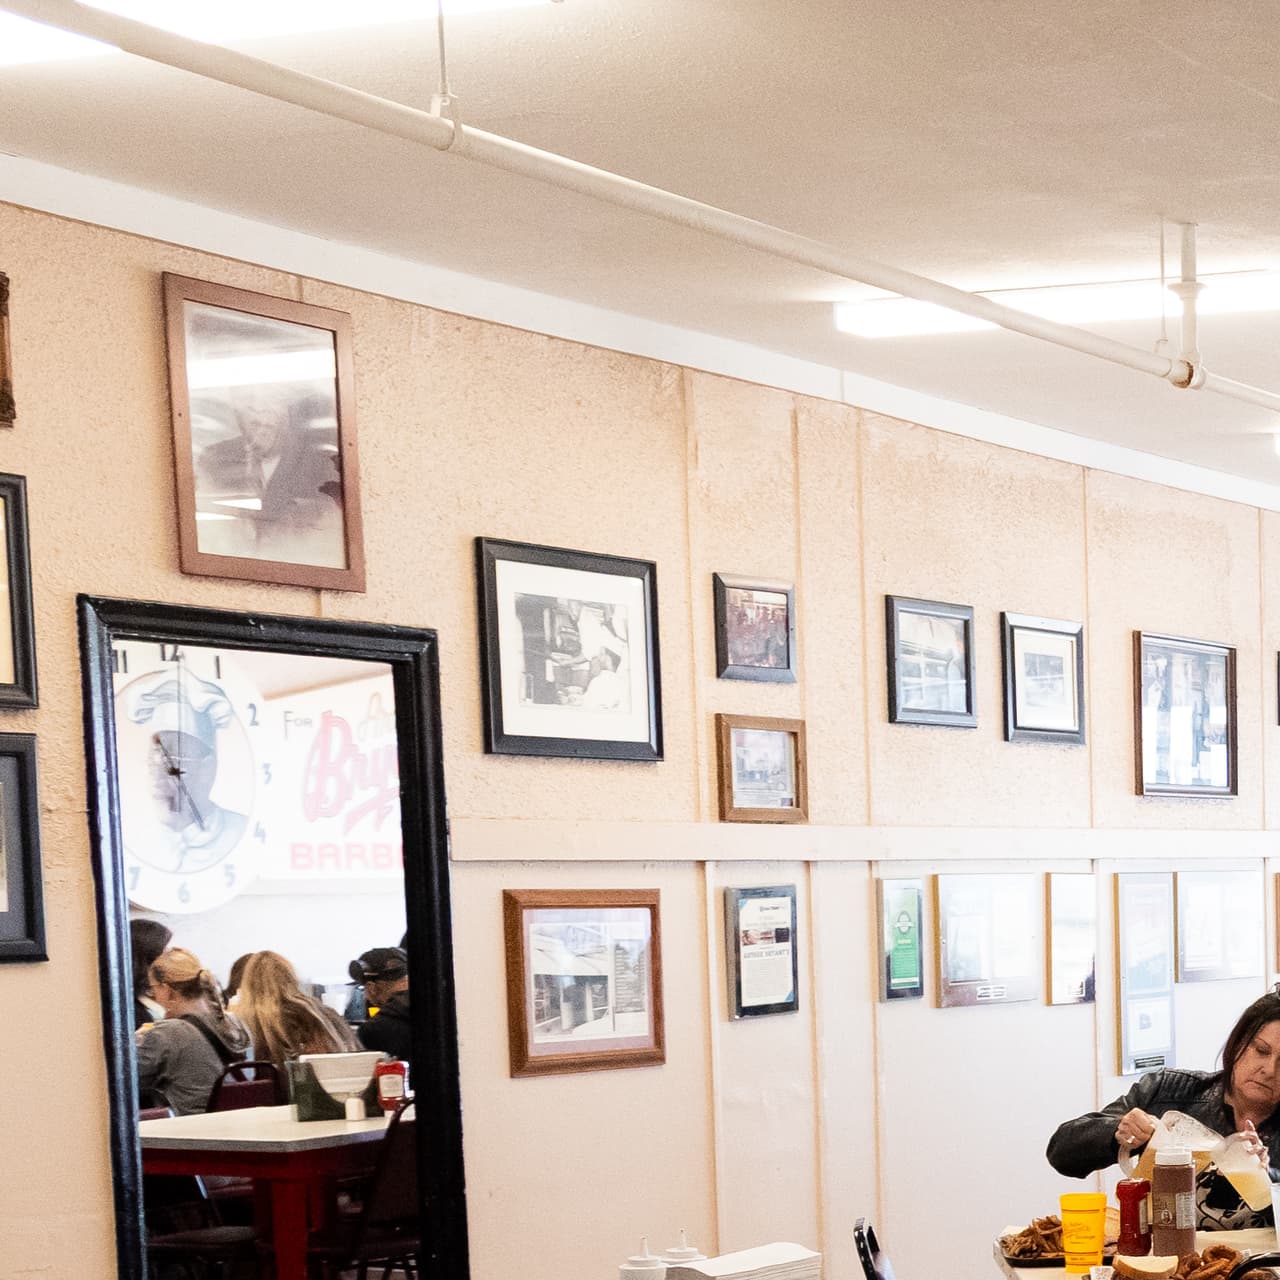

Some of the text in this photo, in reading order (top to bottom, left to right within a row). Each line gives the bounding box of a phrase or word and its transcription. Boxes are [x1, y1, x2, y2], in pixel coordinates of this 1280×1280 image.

[247, 703, 260, 727] 2
[261, 762, 273, 785] 3
[289, 841, 404, 871] BARB
